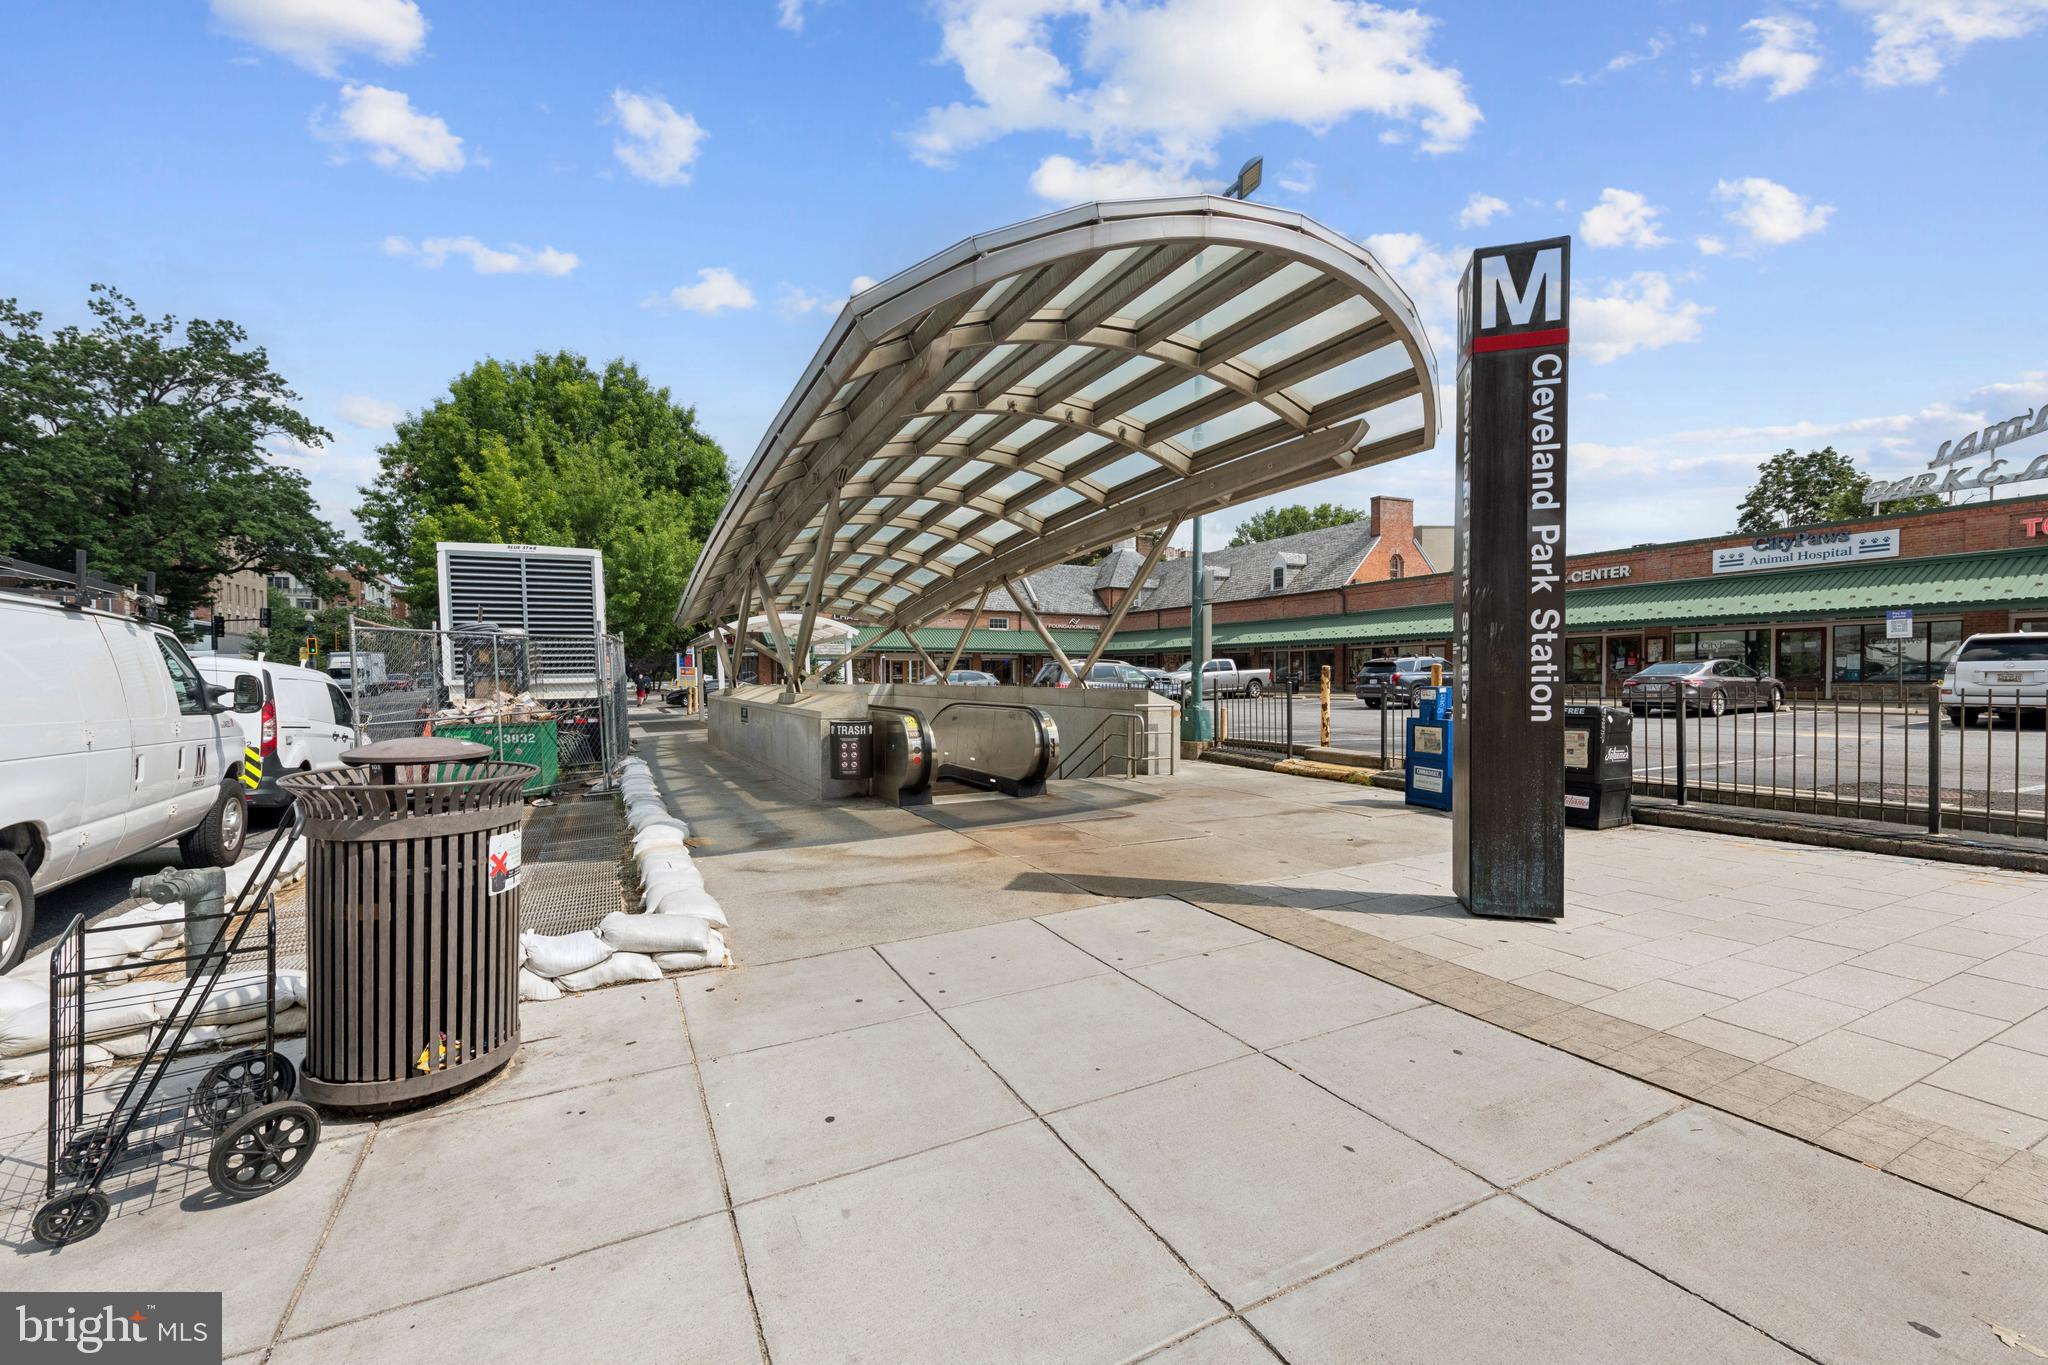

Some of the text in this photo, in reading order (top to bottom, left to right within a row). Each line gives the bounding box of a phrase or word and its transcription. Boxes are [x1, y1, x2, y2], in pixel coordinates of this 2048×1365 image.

[1481, 247, 1562, 329] M
[1861, 466, 1974, 503] PARK
[1530, 353, 1563, 722] Cleveland Park Station
[1750, 547, 1852, 566] Animal Hospital
[837, 725, 866, 735] TRASH
